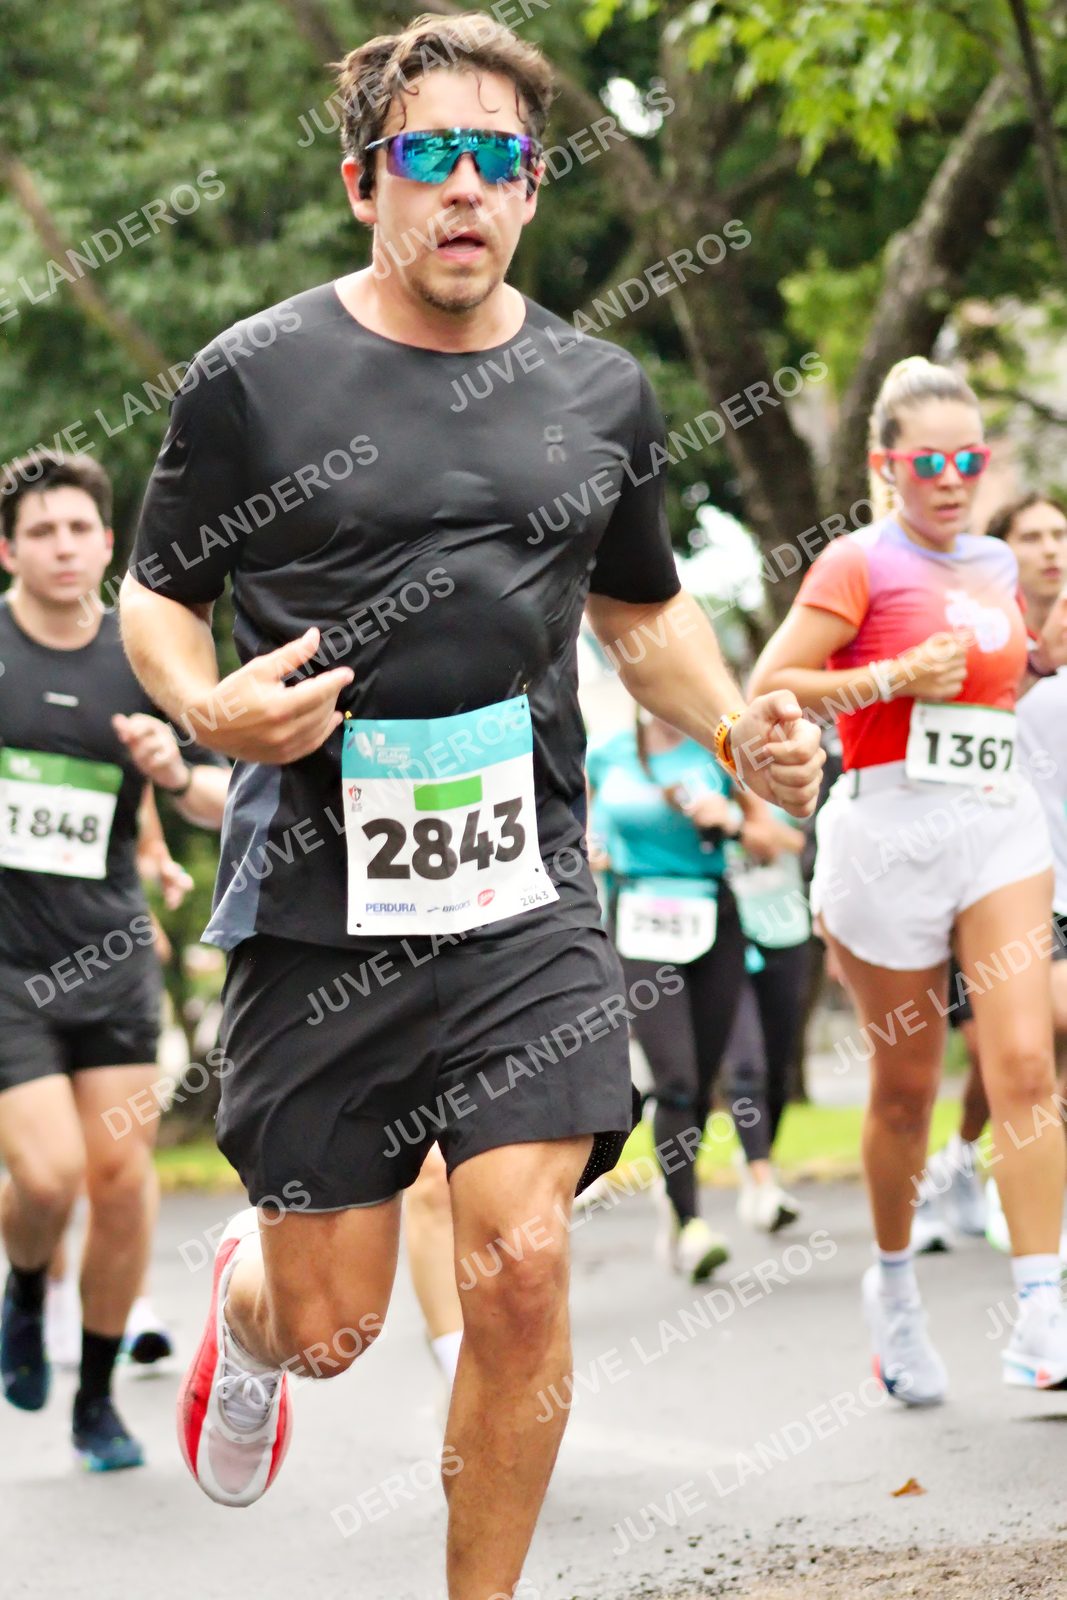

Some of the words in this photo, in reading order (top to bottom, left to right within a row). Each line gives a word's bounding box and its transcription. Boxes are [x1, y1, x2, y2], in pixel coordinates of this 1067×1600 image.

[925, 731, 1013, 771] 1367
[362, 797, 526, 880] 2843
[366, 903, 416, 913] PERDURA
[520, 890, 549, 907] 2843
